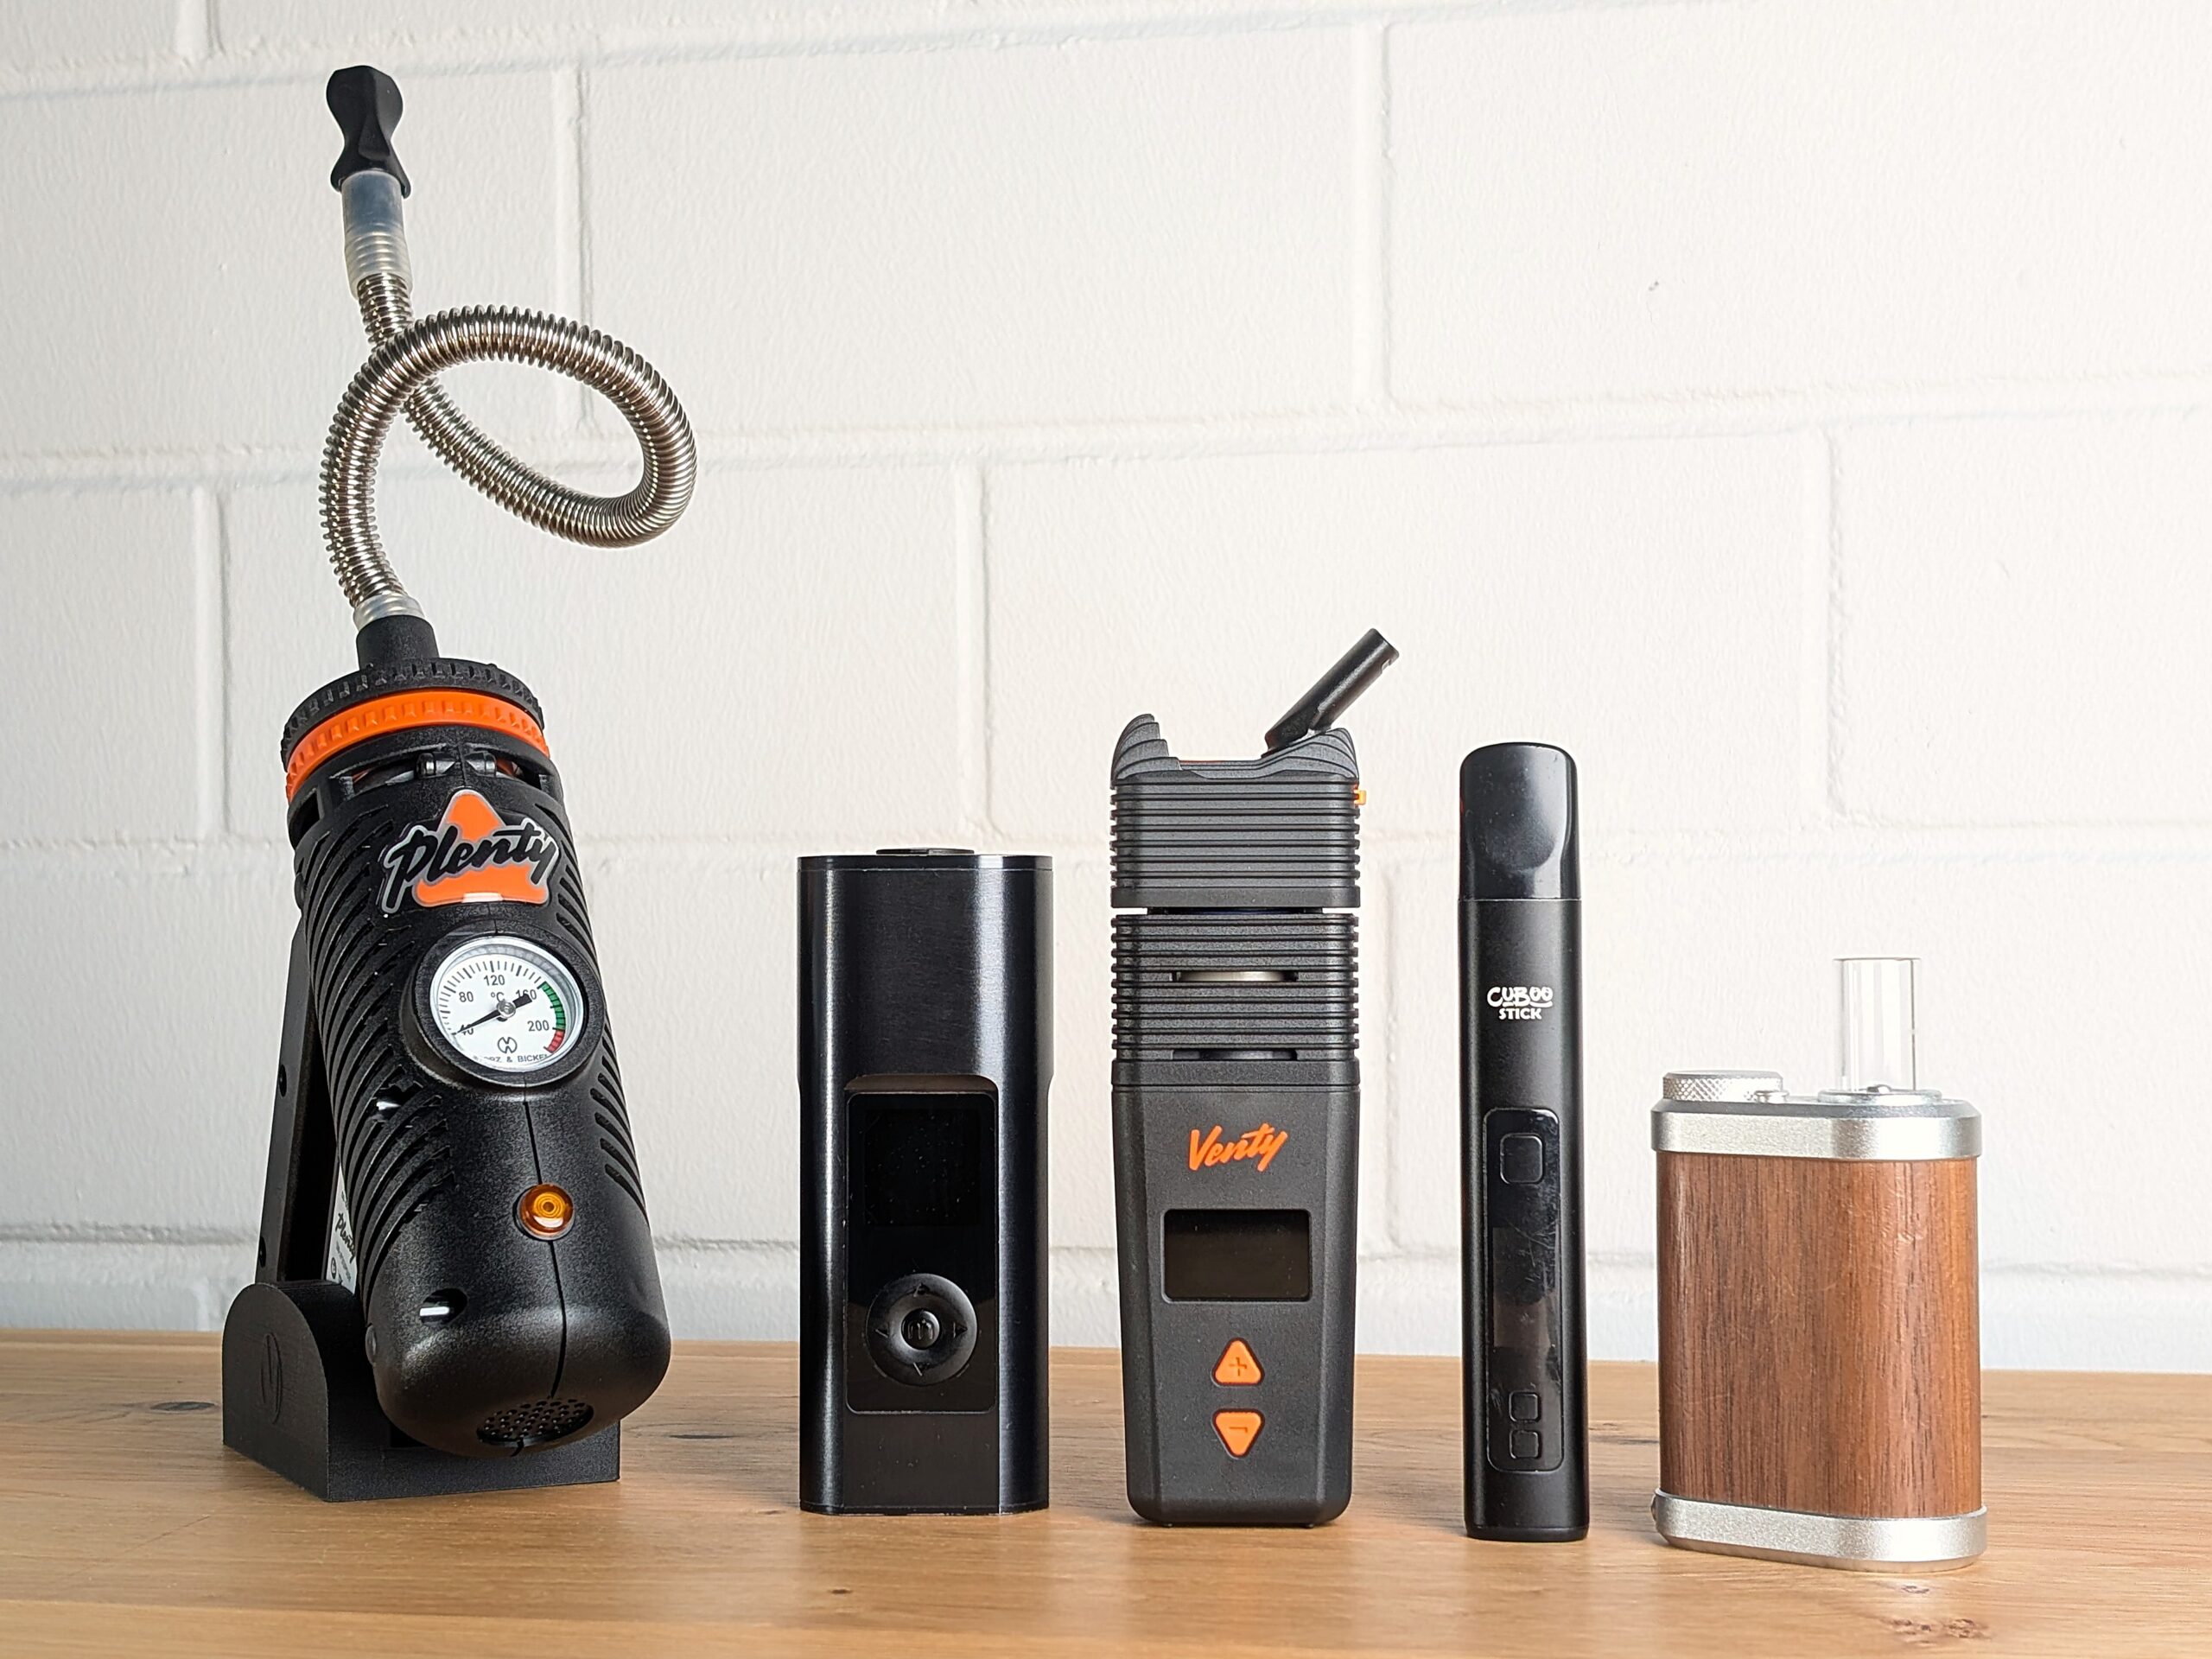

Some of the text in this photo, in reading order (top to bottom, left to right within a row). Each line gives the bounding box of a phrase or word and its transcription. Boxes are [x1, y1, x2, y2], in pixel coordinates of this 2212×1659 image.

[384, 819, 558, 912] Plenty
[483, 975, 505, 987] 120
[458, 991, 474, 1003] 80
[1498, 1007, 1542, 1020] STICK
[527, 1020, 550, 1032] 200
[1188, 1122, 1288, 1172] Venty
